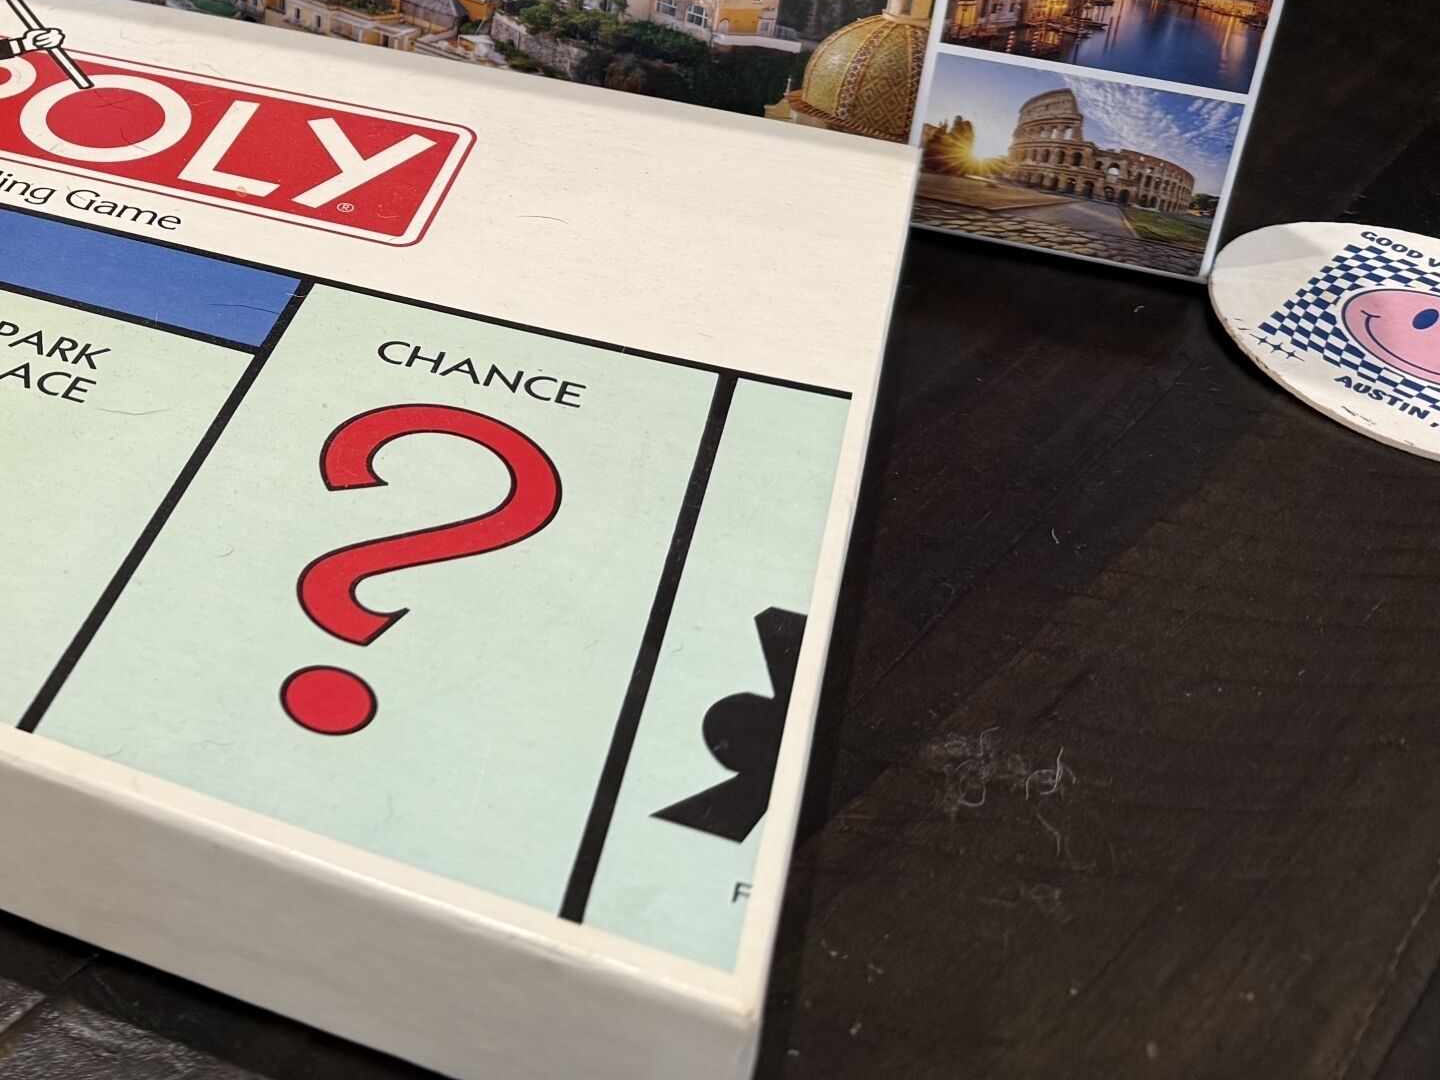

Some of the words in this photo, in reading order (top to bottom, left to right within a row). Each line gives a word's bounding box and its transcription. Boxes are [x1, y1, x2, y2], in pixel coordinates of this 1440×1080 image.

[65, 190, 182, 231] Game
[1360, 230, 1424, 260] GOOD
[377, 340, 587, 409] CHANCE
